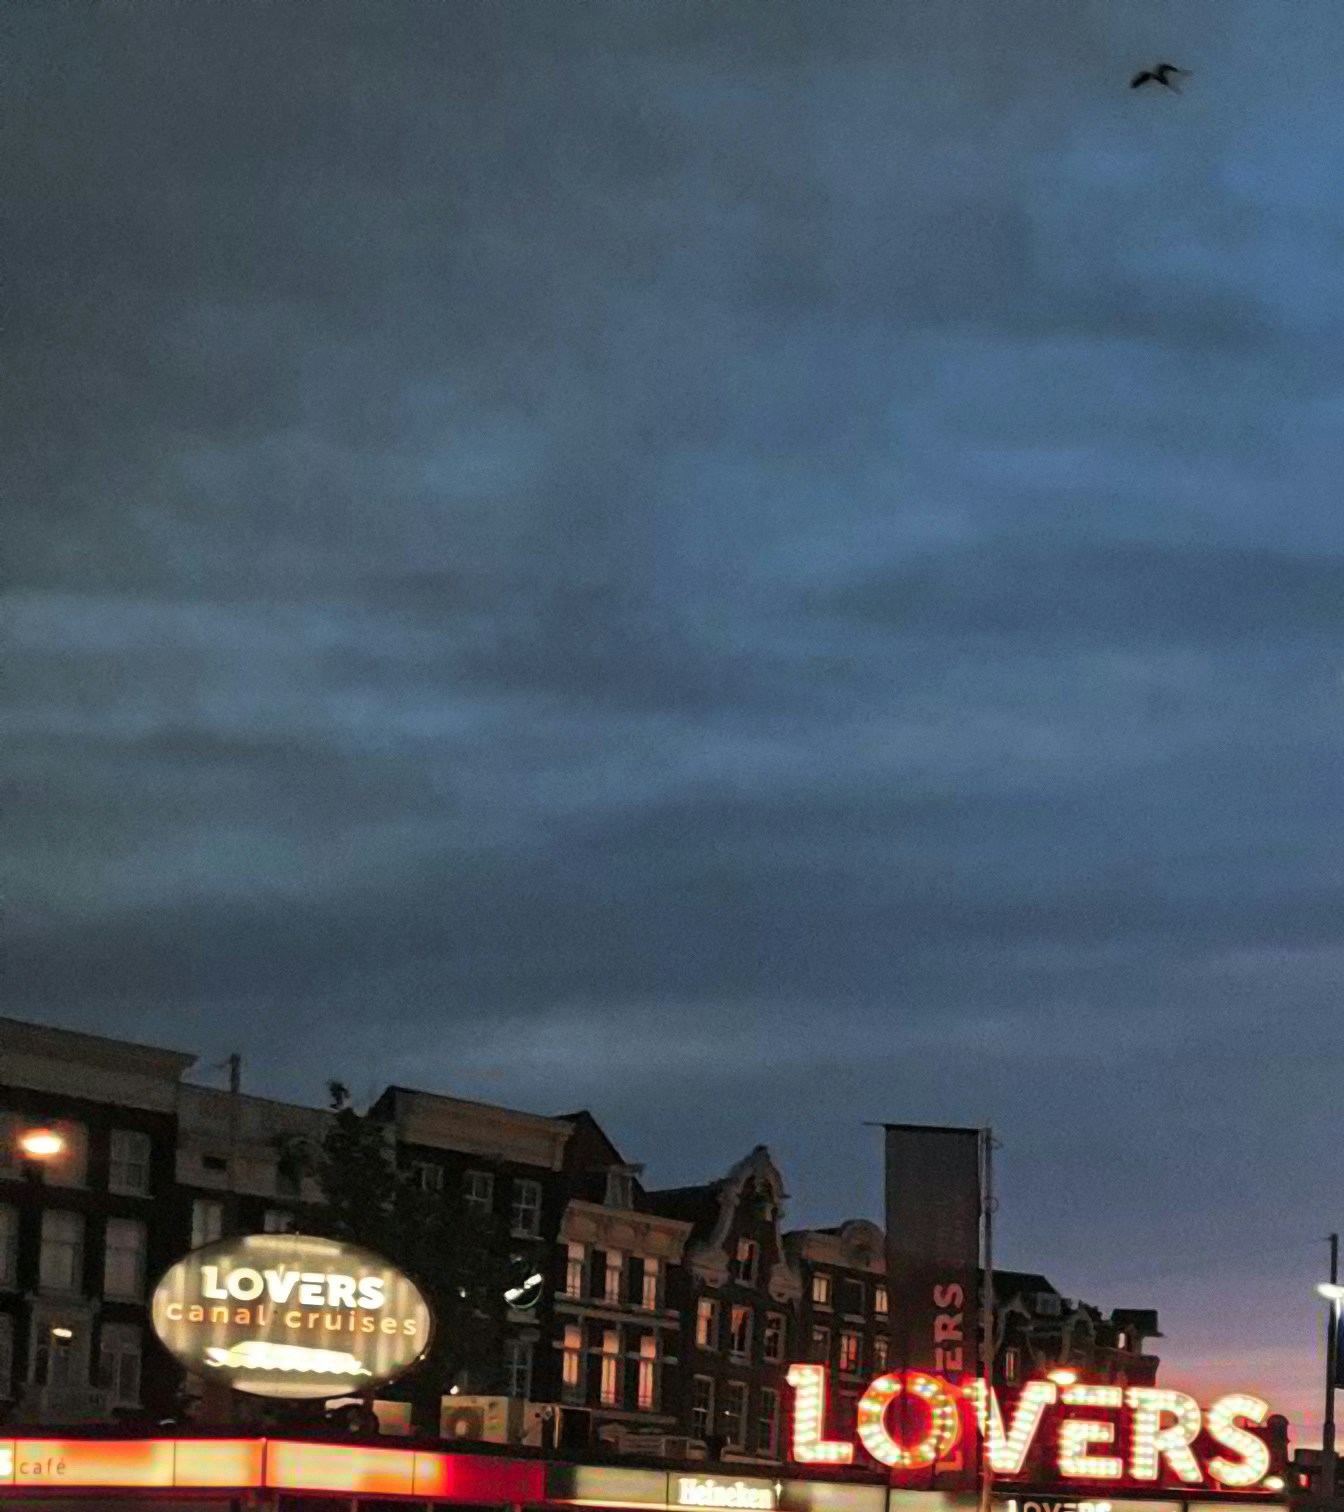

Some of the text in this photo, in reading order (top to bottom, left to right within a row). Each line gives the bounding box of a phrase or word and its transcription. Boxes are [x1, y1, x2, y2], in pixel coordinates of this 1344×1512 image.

[201, 1265, 385, 1310] LOVERS
[166, 1302, 418, 1336] canal cruises
[933, 1282, 964, 1475] LERS
[786, 1363, 1272, 1487] LOVERS
[678, 1478, 772, 1509] Heineken
